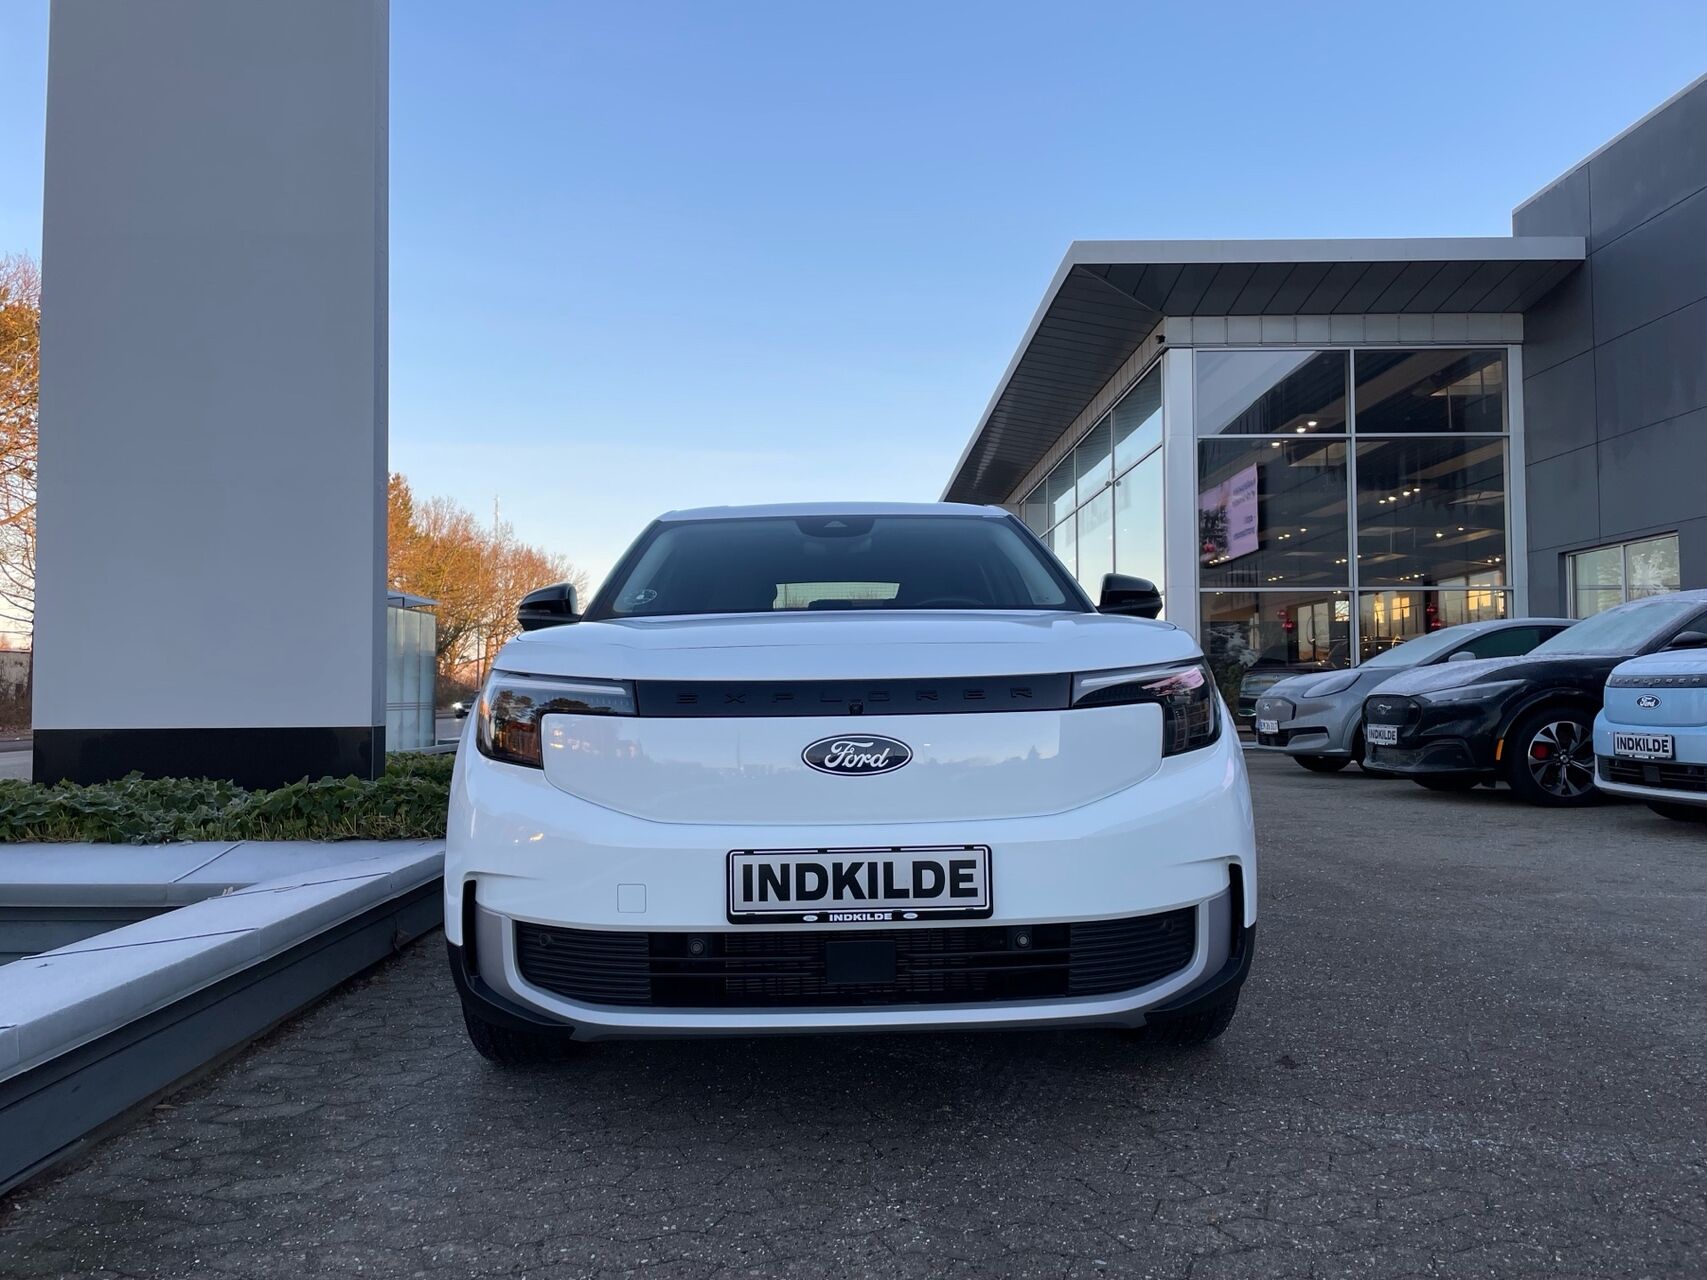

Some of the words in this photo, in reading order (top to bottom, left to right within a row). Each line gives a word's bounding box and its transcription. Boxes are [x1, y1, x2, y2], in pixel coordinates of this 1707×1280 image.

[677, 686, 1033, 704] EXPLORER
[1368, 728, 1396, 741] INDKILDE
[824, 740, 891, 768] Ford
[1616, 736, 1670, 754] INDKILDE
[742, 859, 979, 903] INDKILDE
[829, 912, 893, 922] INDKILDE
